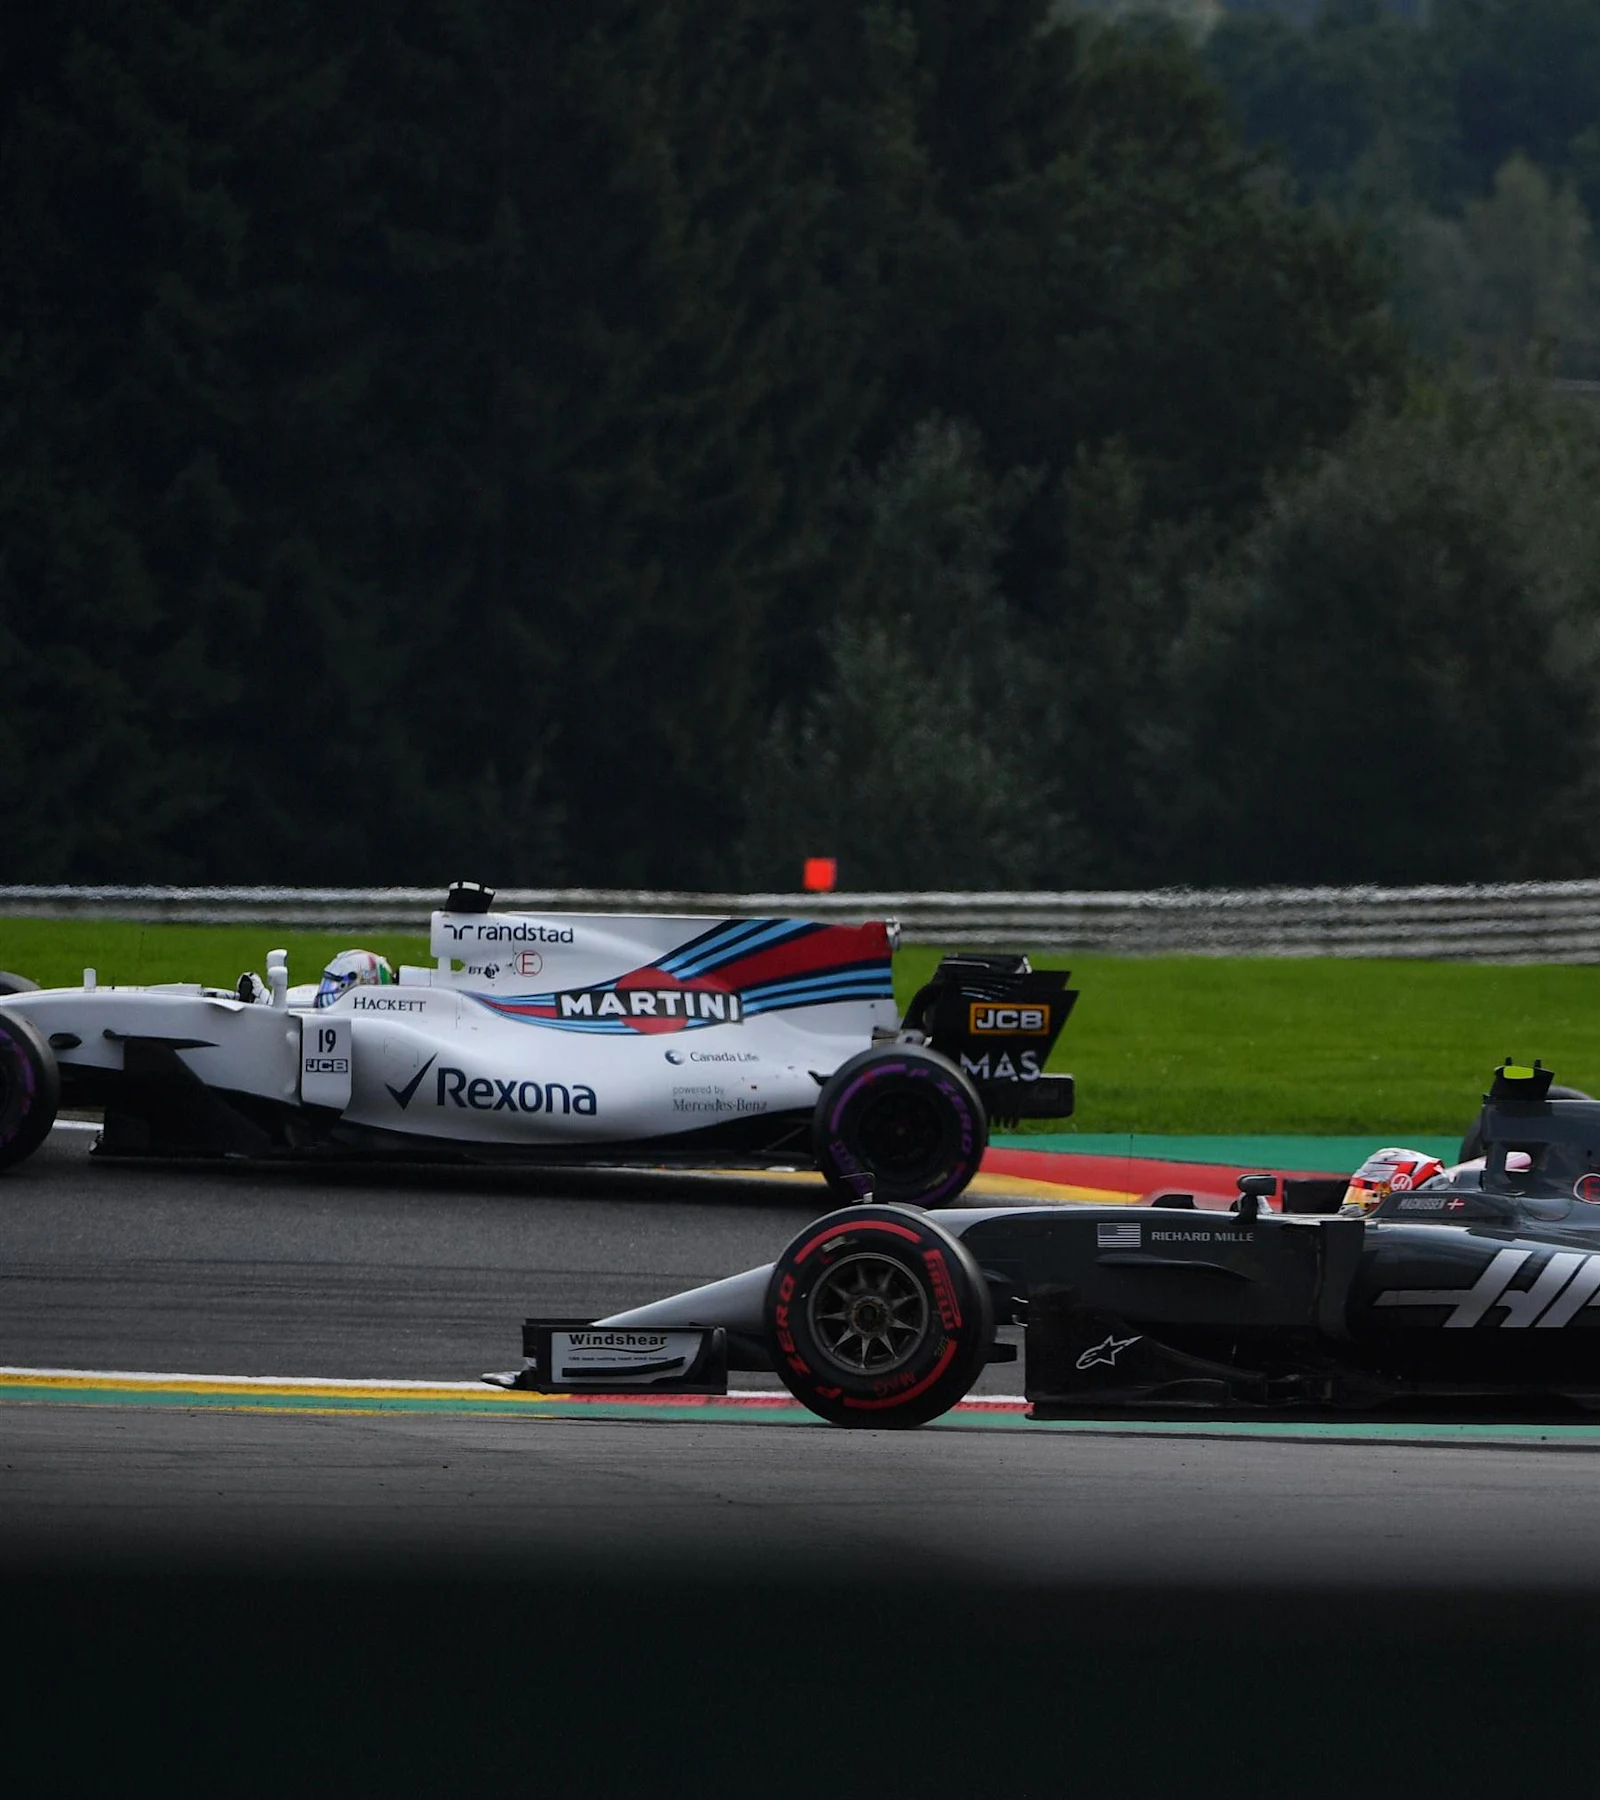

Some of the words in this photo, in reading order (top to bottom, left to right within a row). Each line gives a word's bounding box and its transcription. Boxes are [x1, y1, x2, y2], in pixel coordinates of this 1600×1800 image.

[477, 923, 574, 943] randstad
[521, 953, 537, 975] E
[353, 997, 427, 1012] HACKETT
[560, 991, 739, 1021] MARTINI
[976, 1008, 1043, 1031] JCB
[318, 1029, 337, 1053] 19
[690, 1051, 736, 1062] Canada
[306, 1059, 349, 1073] JCB
[437, 1067, 597, 1116] Rexona
[672, 1085, 711, 1096] powered
[1151, 1231, 1210, 1242] RICHARD
[1215, 1232, 1254, 1242] MILLE
[569, 1334, 667, 1345] Windshear
